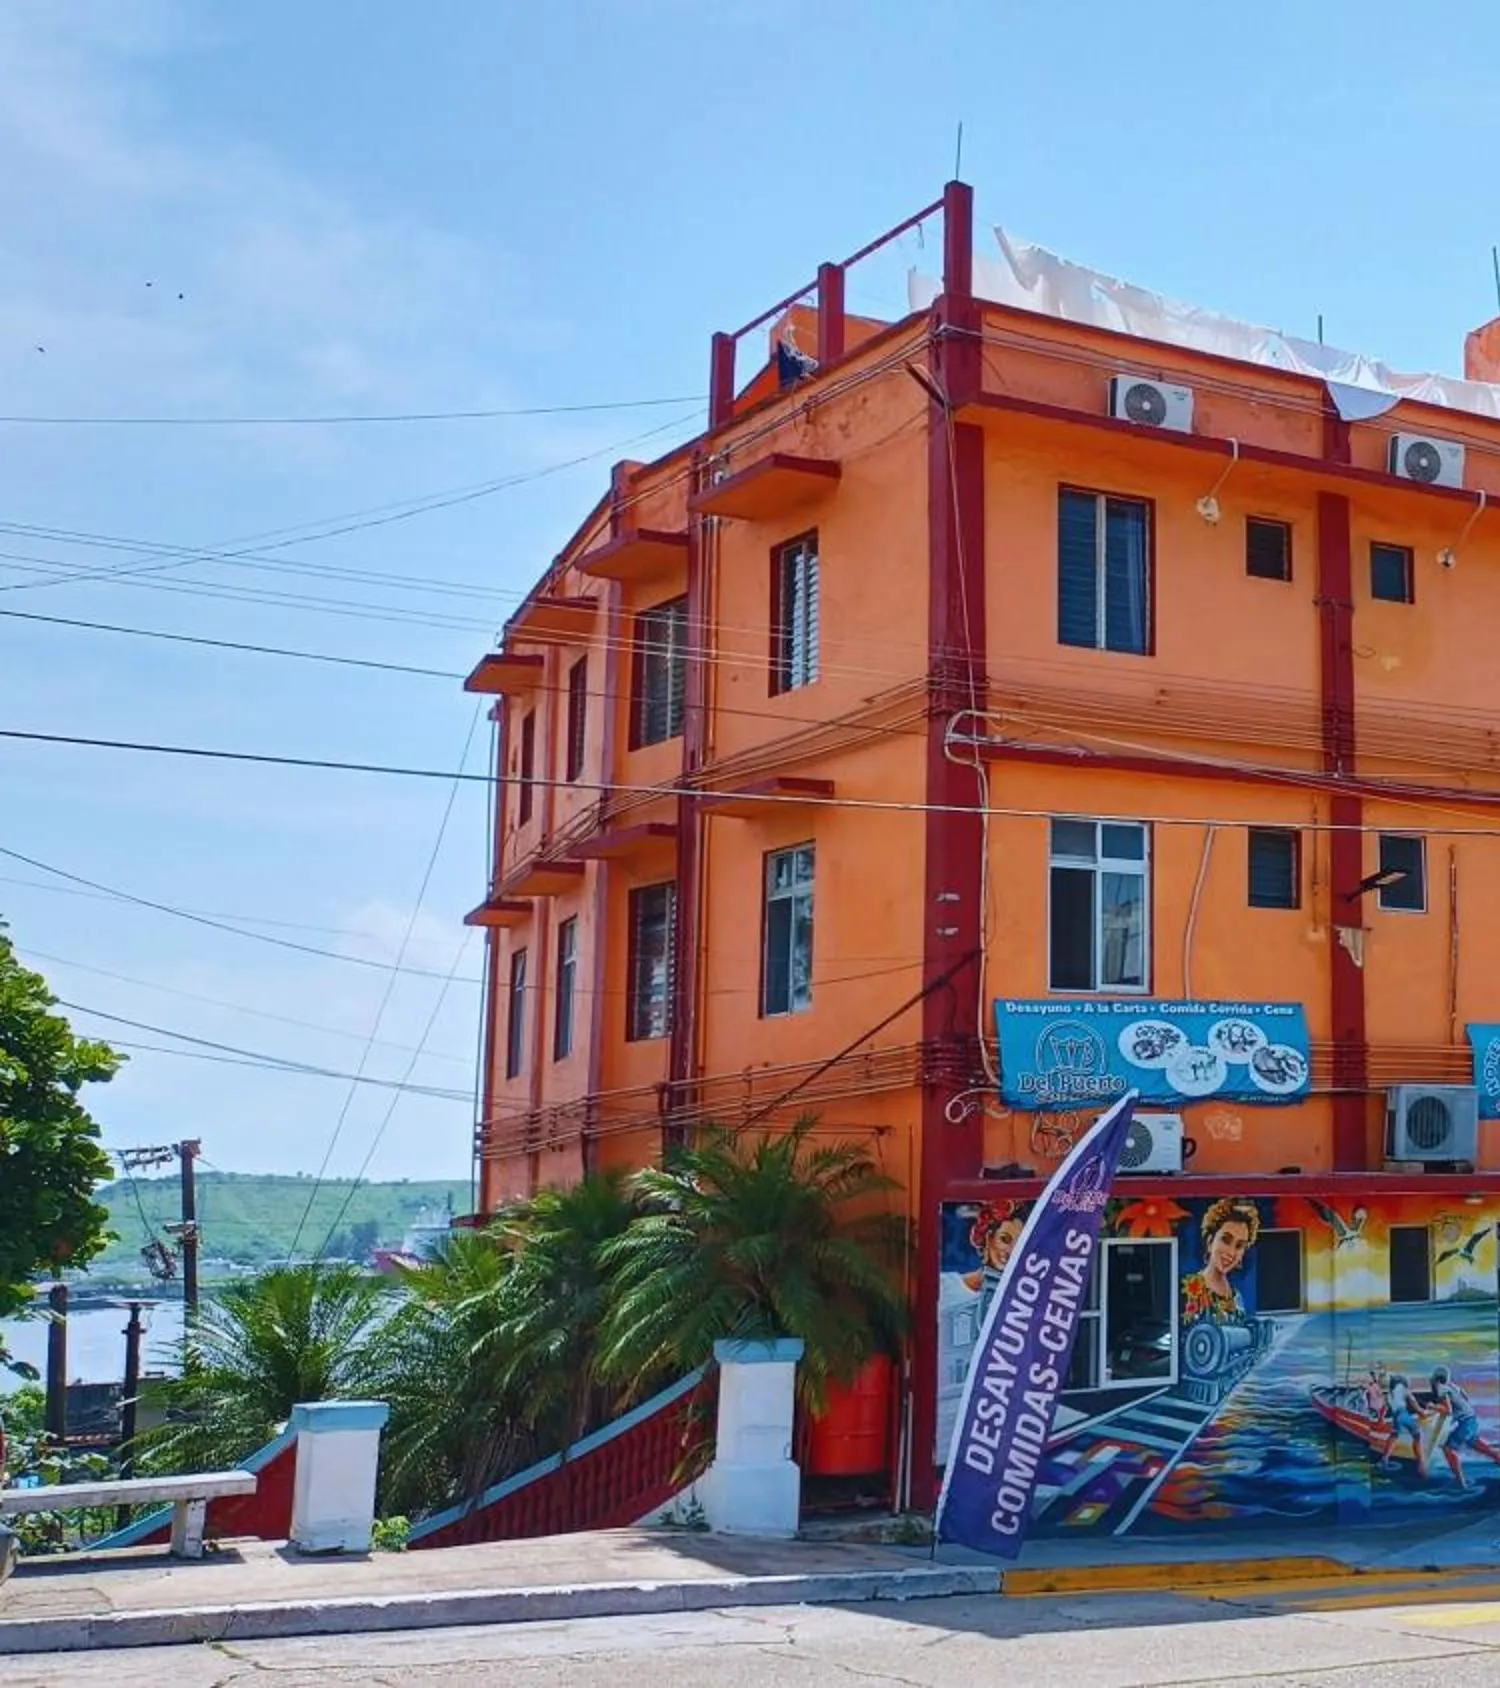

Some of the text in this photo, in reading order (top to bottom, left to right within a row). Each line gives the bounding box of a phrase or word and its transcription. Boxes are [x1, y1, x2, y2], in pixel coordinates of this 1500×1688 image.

[1005, 1001, 1072, 1015] Desayuno
[1113, 1002, 1147, 1013] Carta
[1160, 1003, 1205, 1014] Comida
[1208, 1003, 1253, 1015] Corrida
[1264, 1005, 1294, 1015] Cena
[1018, 1072, 1127, 1093] Del Puerto
[964, 1253, 1051, 1475] DESAYUNOS
[990, 1228, 1094, 1537] COMIDAS-CENAS
